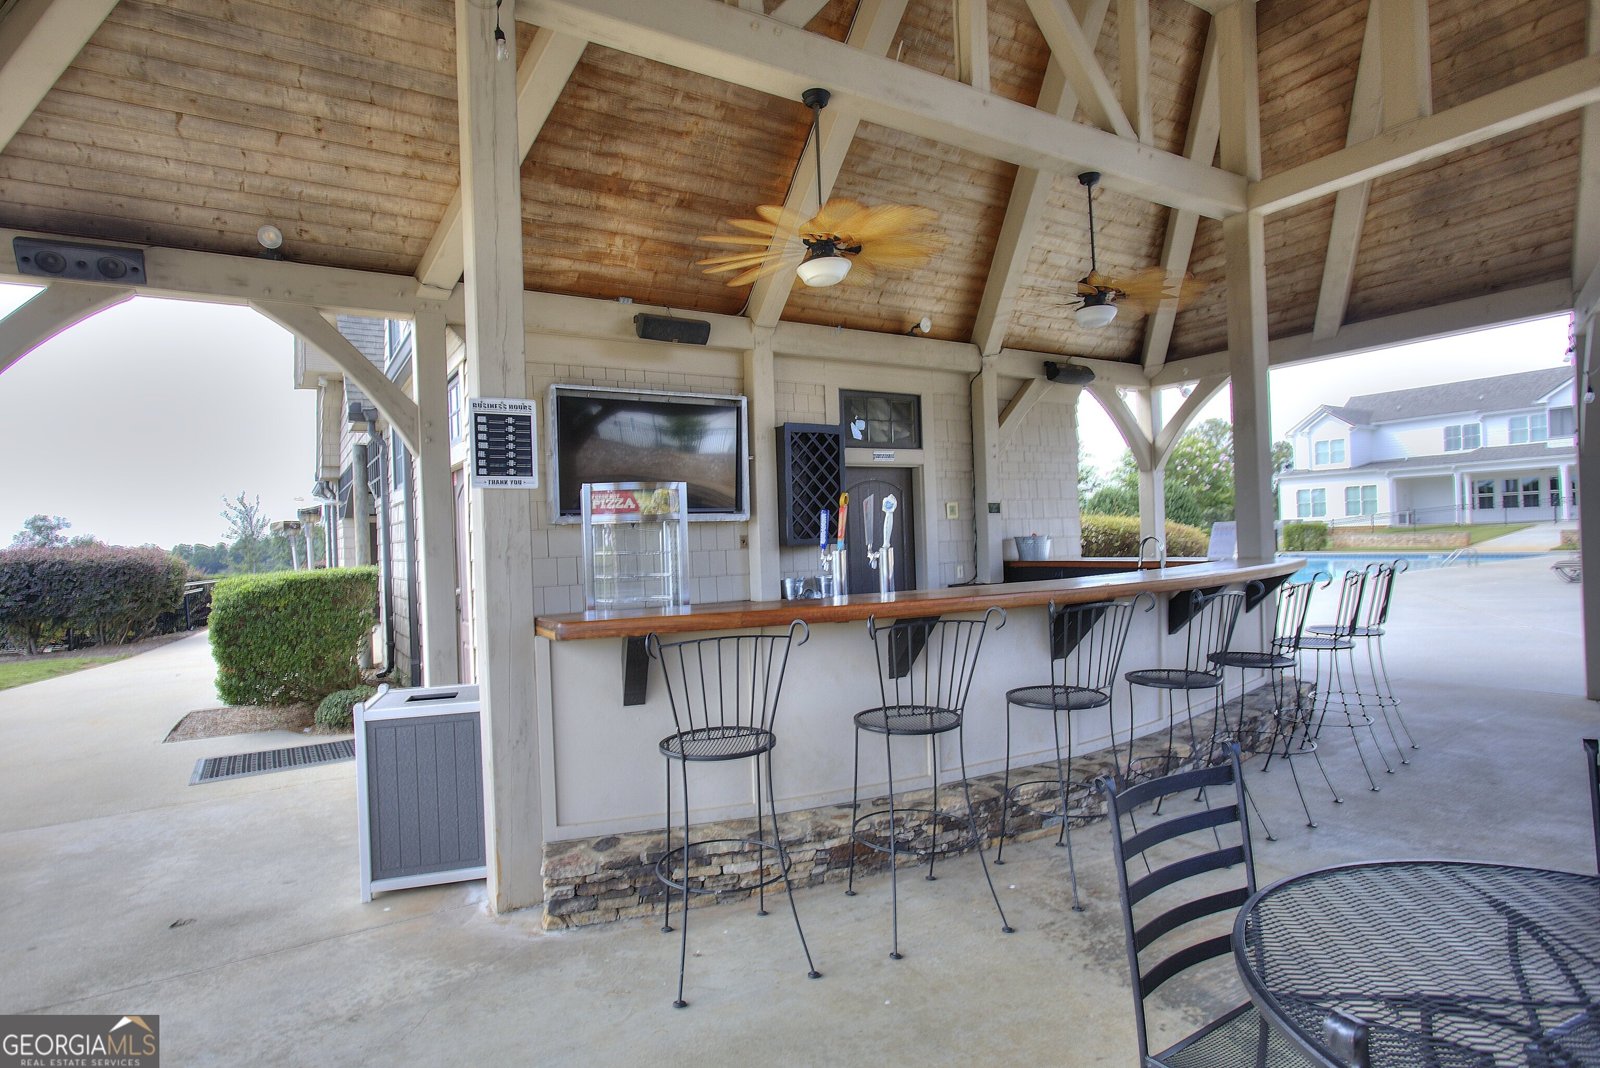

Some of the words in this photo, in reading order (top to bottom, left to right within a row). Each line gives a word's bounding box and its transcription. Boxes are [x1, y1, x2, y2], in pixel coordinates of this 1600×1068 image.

[472, 401, 507, 410] BUSINESS
[508, 403, 532, 411] HOURS
[591, 498, 635, 509] PIZZA
